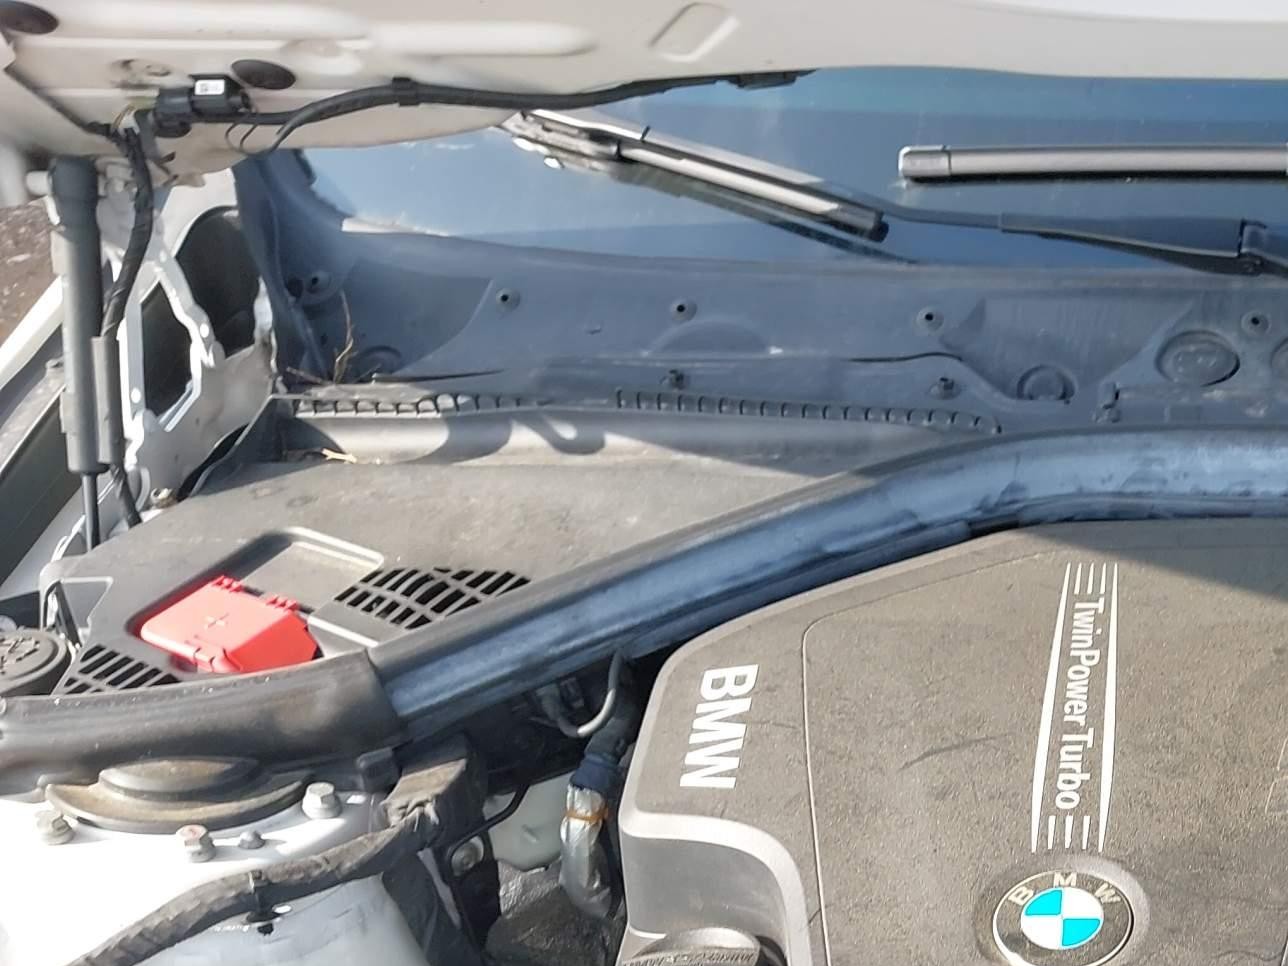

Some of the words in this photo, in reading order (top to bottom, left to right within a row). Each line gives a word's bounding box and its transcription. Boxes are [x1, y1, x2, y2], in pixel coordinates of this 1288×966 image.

[1063, 596, 1105, 727] TwinPower
[679, 664, 759, 789] BMW
[1055, 727, 1095, 810] Turbo
[1008, 871, 1121, 906] BMW
